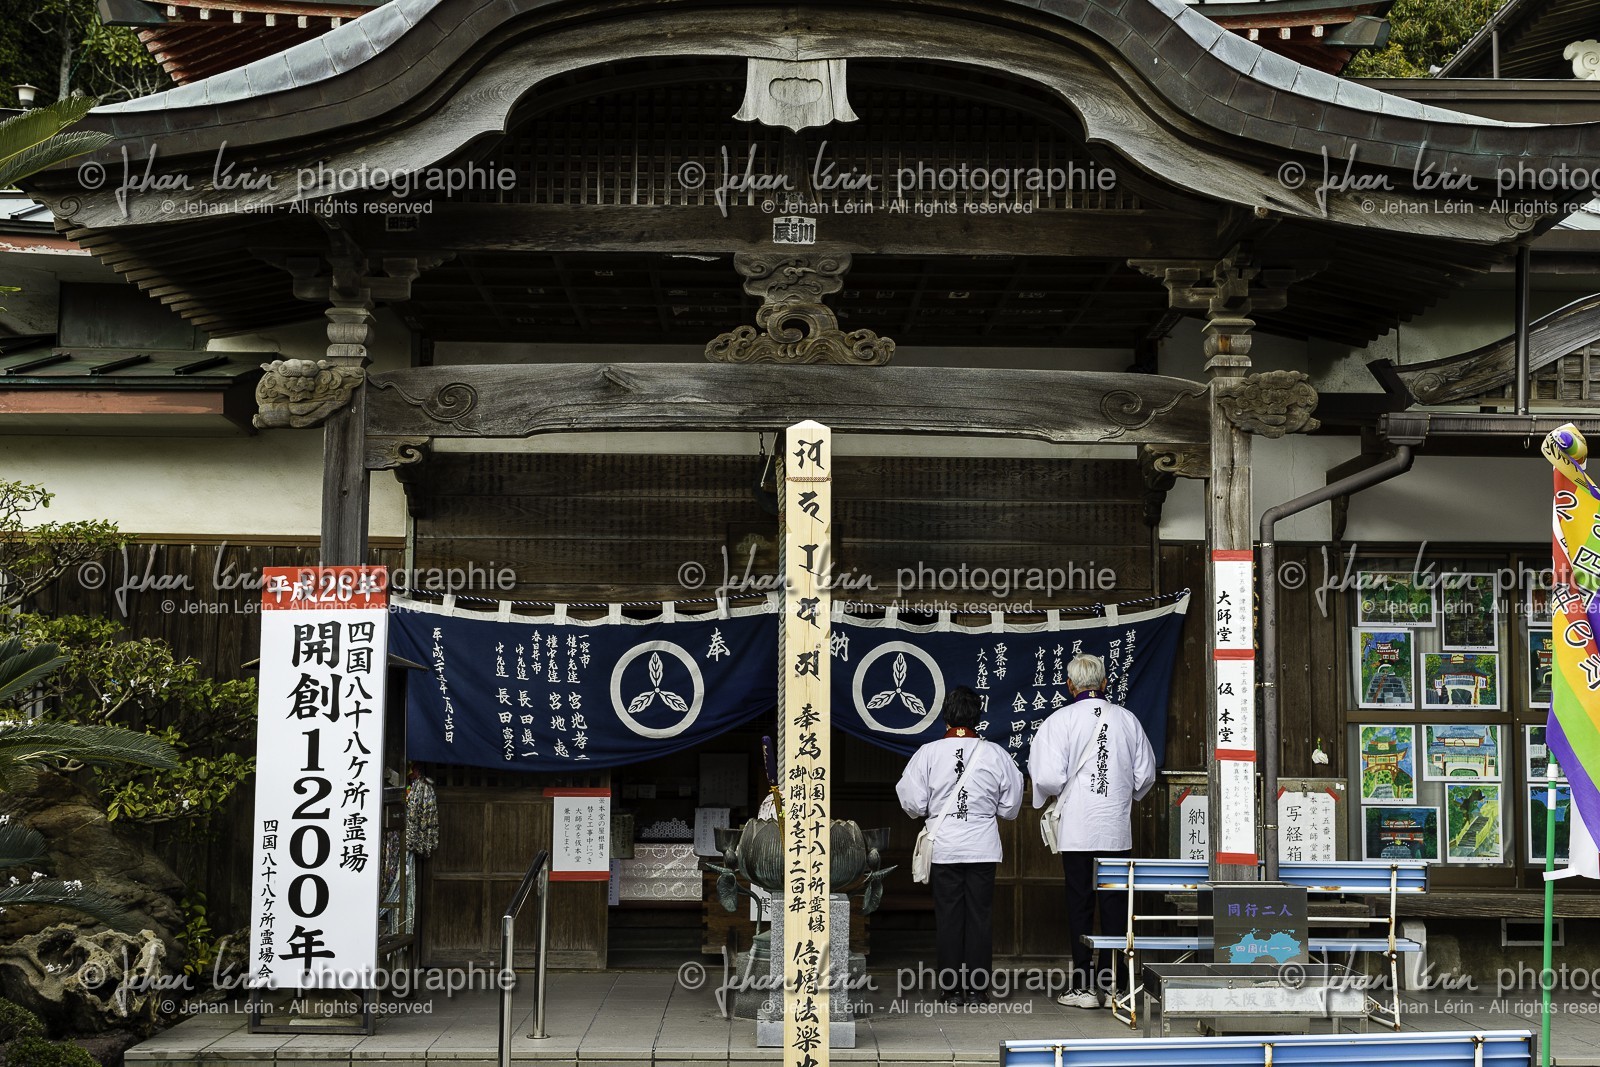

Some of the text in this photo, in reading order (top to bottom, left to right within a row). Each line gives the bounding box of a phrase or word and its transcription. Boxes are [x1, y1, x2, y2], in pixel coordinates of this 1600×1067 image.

[267, 573, 382, 603] 平成26年
[1216, 590, 1233, 642] 大師堂
[705, 626, 731, 662] 奉
[829, 631, 850, 662] 納
[278, 620, 343, 977] 開創1200年
[1285, 805, 1303, 861] 写経箱
[1227, 903, 1293, 917] 同行二人
